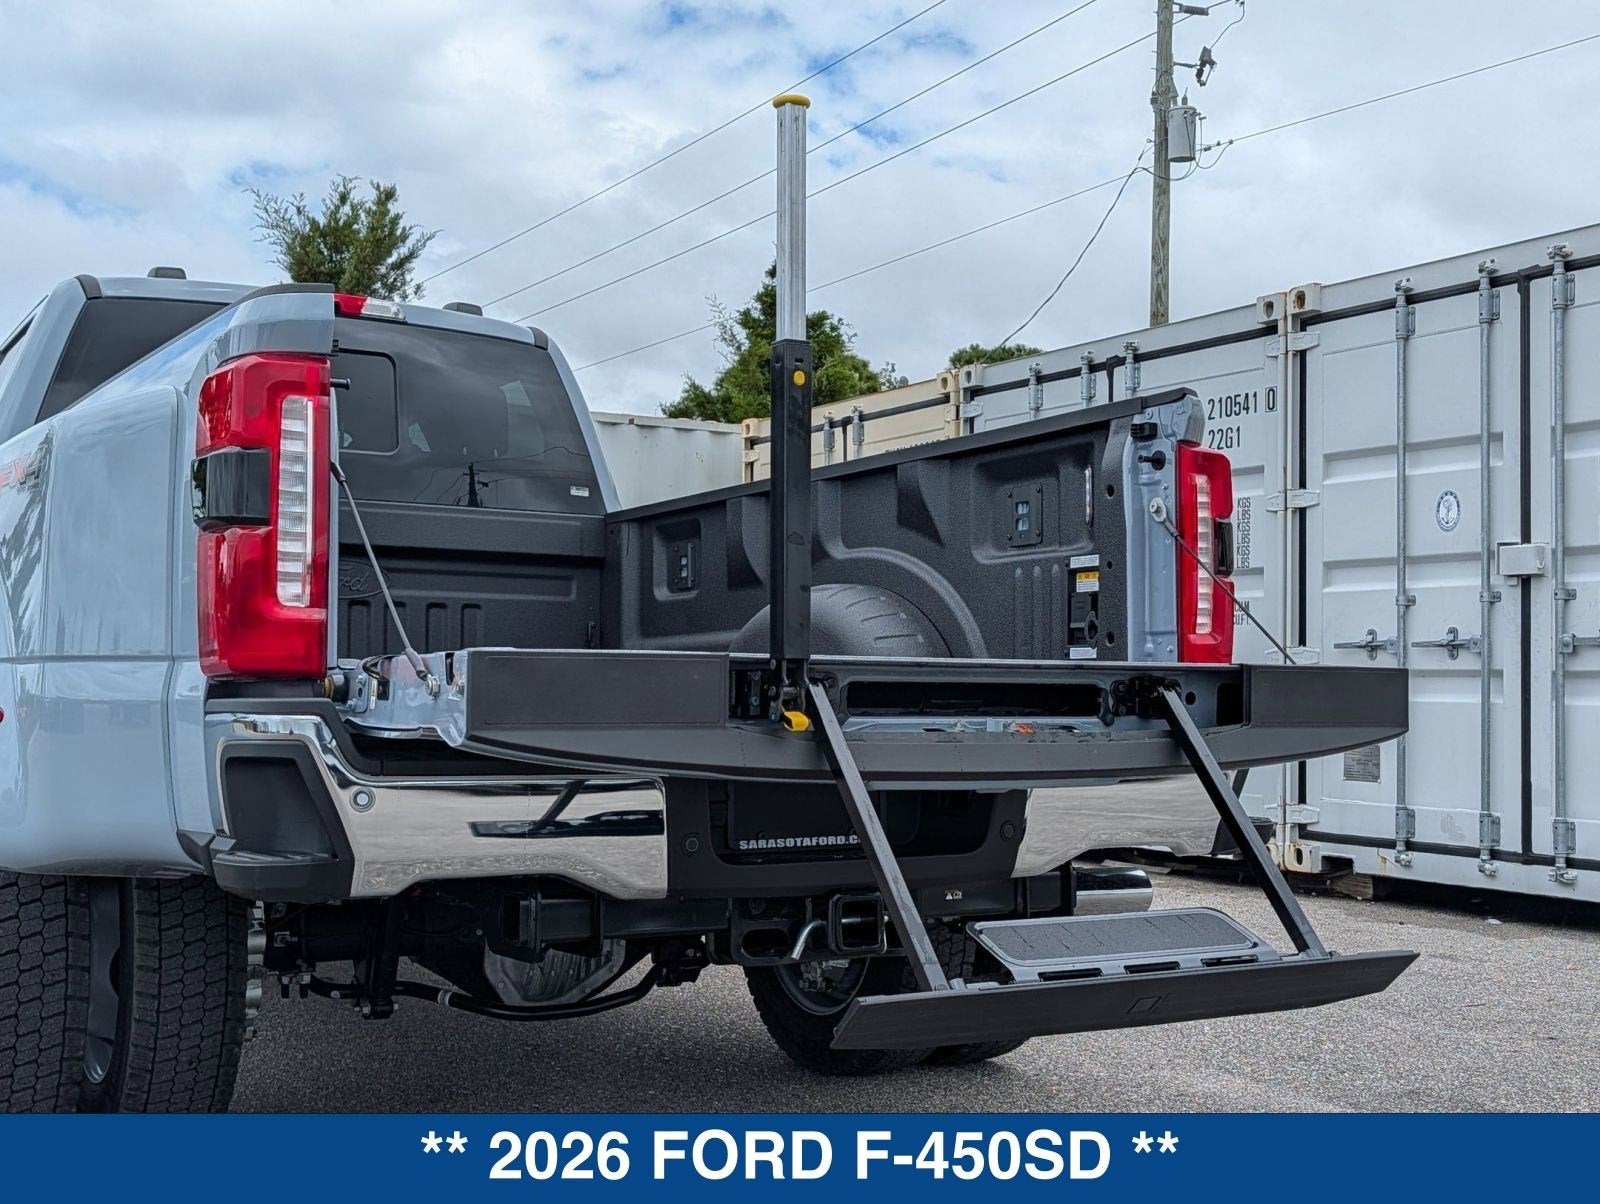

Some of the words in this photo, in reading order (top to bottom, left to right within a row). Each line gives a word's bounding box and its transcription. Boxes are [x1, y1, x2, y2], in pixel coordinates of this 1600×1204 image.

[1207, 390, 1257, 421] 210541
[1266, 388, 1276, 411] 0
[1208, 425, 1241, 450] 22G1
[1237, 496, 1251, 509] KGS
[1237, 509, 1251, 521] LBS
[1237, 521, 1251, 533] KGS
[1237, 533, 1251, 545] LBS
[1237, 545, 1251, 557] KGS
[1237, 557, 1250, 569] LBS
[739, 834, 861, 850] SARASOTAFORD.C
